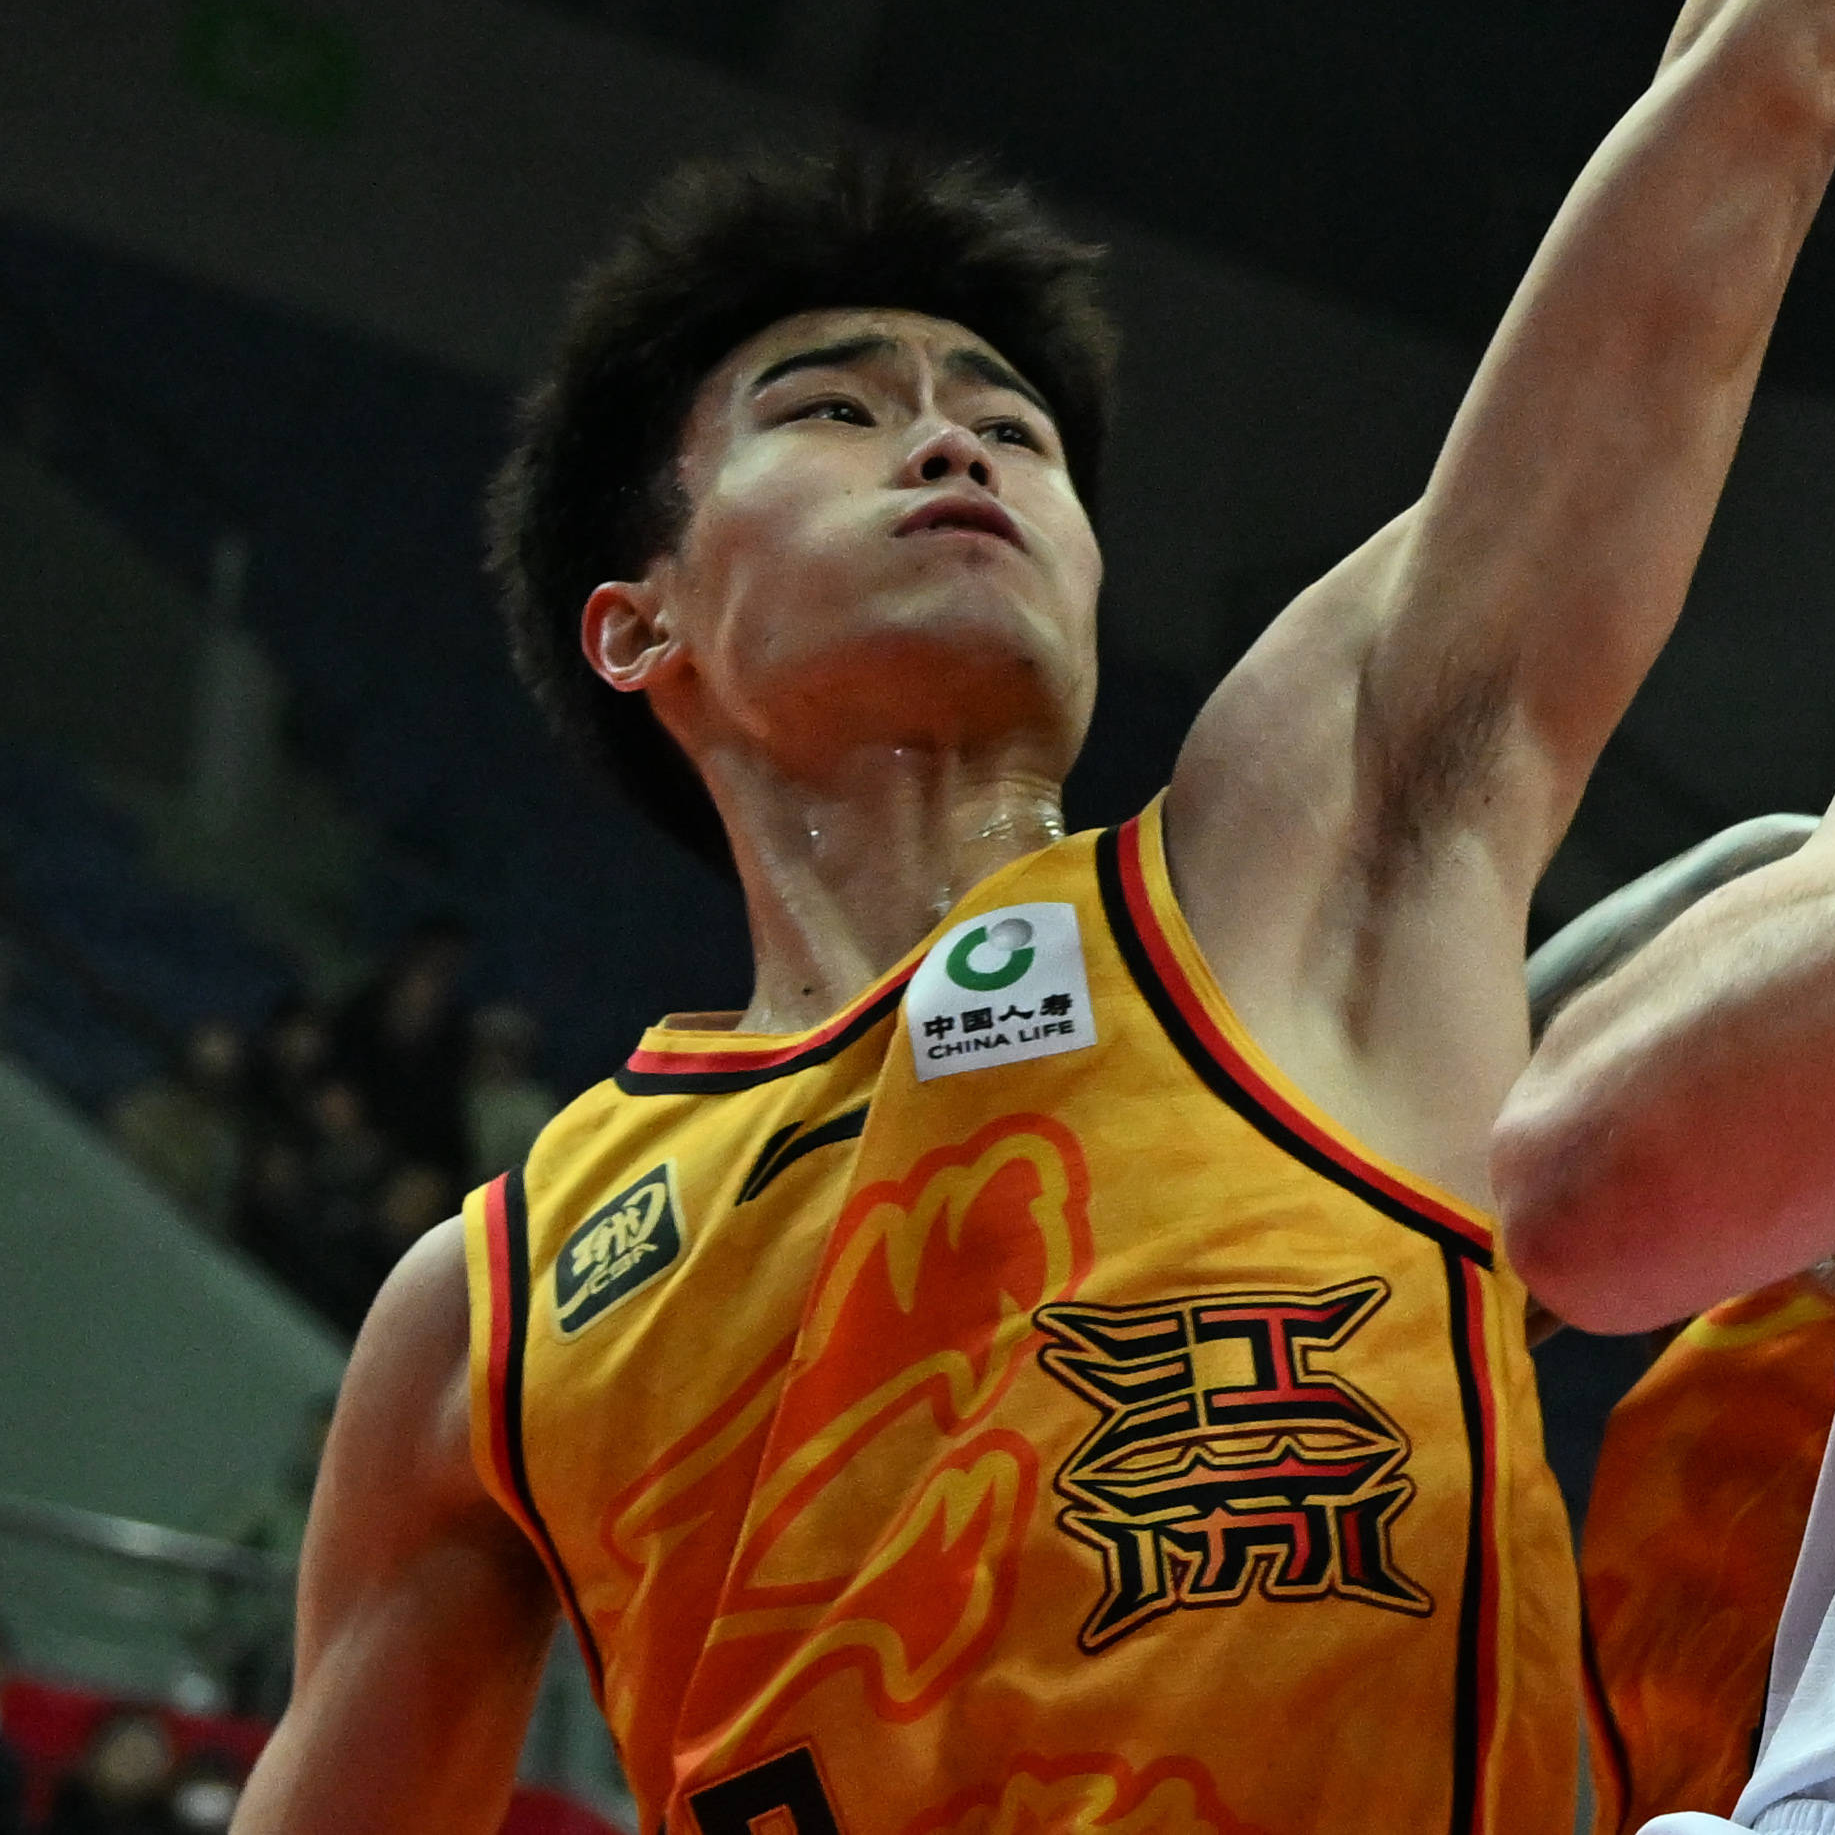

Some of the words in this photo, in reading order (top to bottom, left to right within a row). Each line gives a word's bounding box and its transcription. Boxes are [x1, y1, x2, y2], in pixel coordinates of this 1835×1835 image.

[923, 993, 1074, 1041] 中国人寿
[927, 1033, 1011, 1061] CHINA
[1018, 1019, 1076, 1044] LIFE
